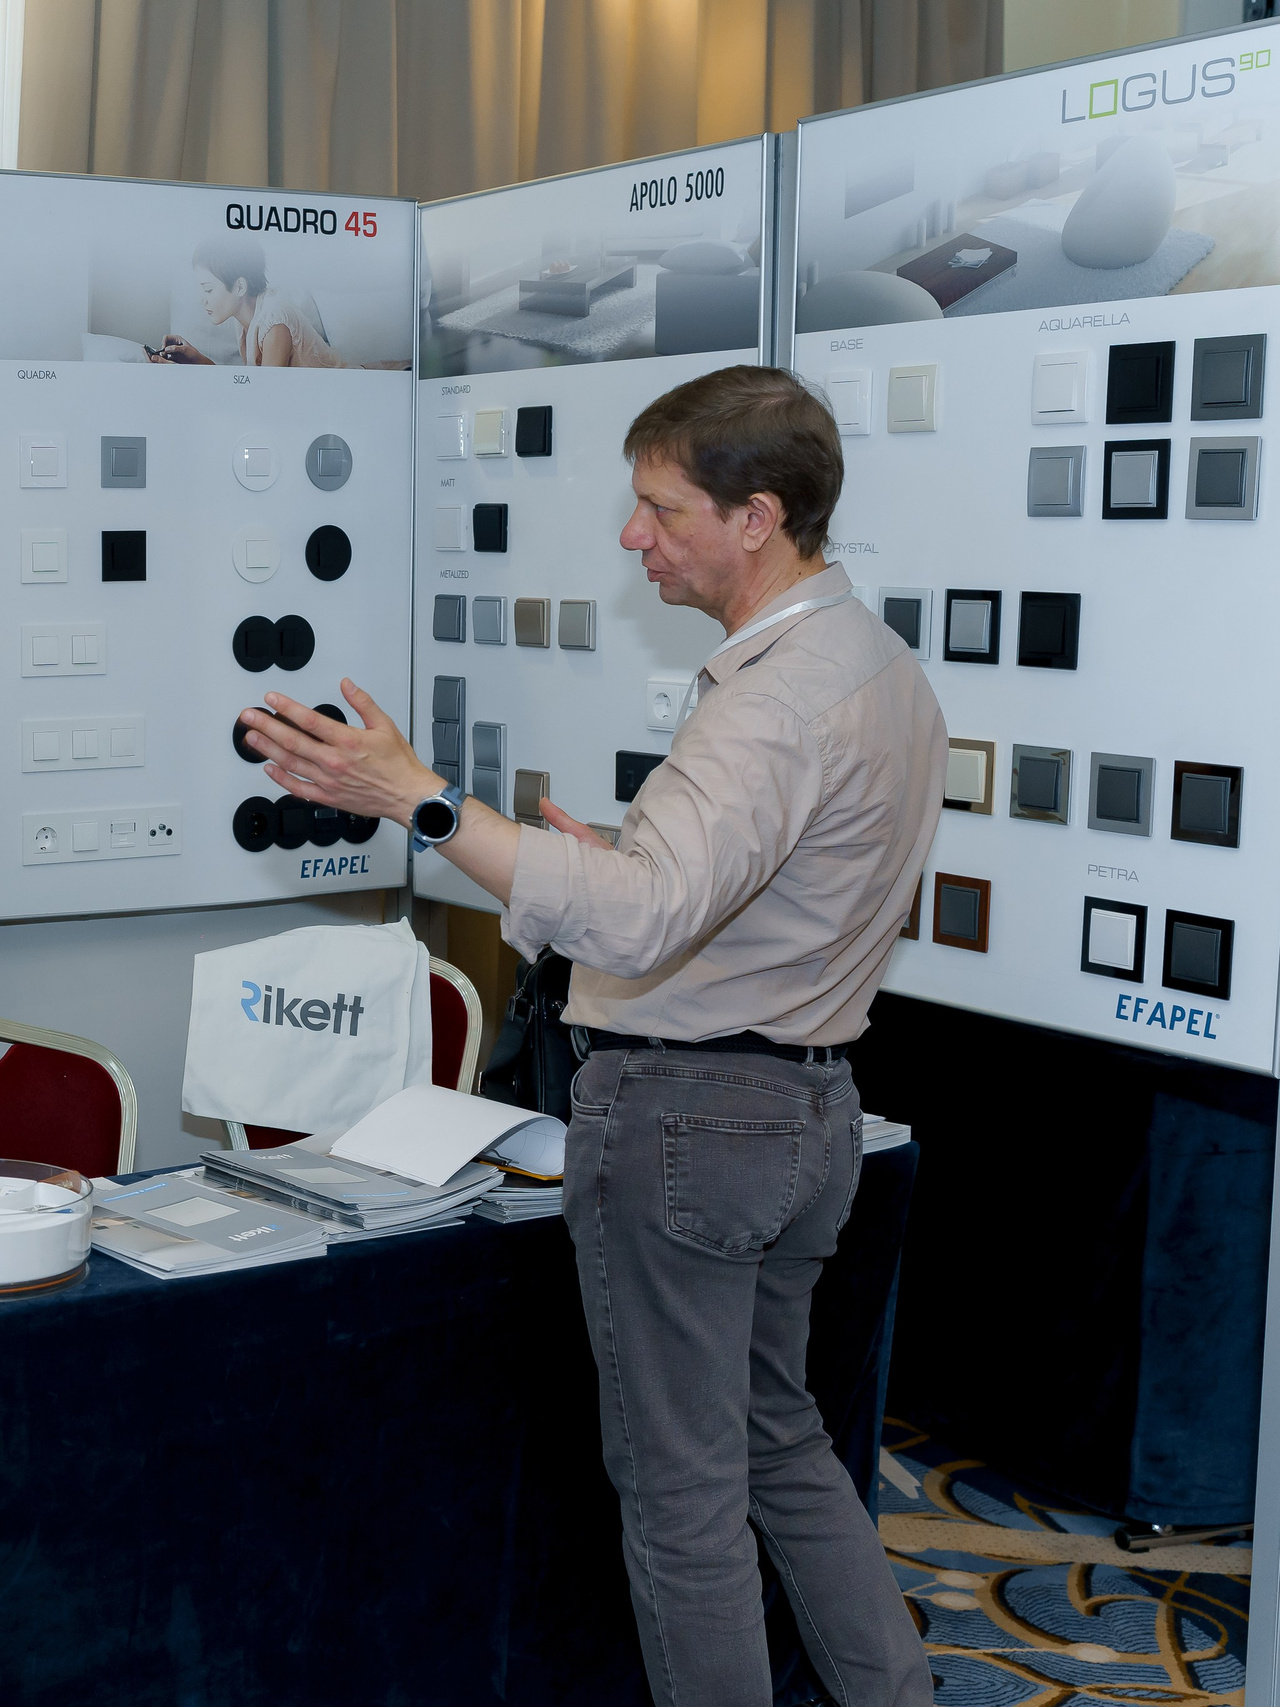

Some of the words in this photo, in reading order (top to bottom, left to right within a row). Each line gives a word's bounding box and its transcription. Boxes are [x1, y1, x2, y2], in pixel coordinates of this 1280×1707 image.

[1061, 57, 1236, 125] LOGUS
[629, 176, 678, 212] APOLO
[685, 166, 725, 203] 5000
[226, 203, 338, 236] QUADRO
[344, 211, 378, 238] 45
[1038, 312, 1131, 333] AQUARELLA
[830, 338, 864, 352] BASE
[17, 369, 58, 380] QUADRA
[233, 374, 251, 384] SIZA
[441, 384, 472, 396] STANDARD
[440, 478, 456, 488] MATT
[439, 569, 470, 579] METALIZED
[300, 854, 370, 879] EFAPEL
[1087, 863, 1140, 883] PETRA
[240, 980, 365, 1037] Rikett
[1115, 993, 1218, 1040] EFAPEL
